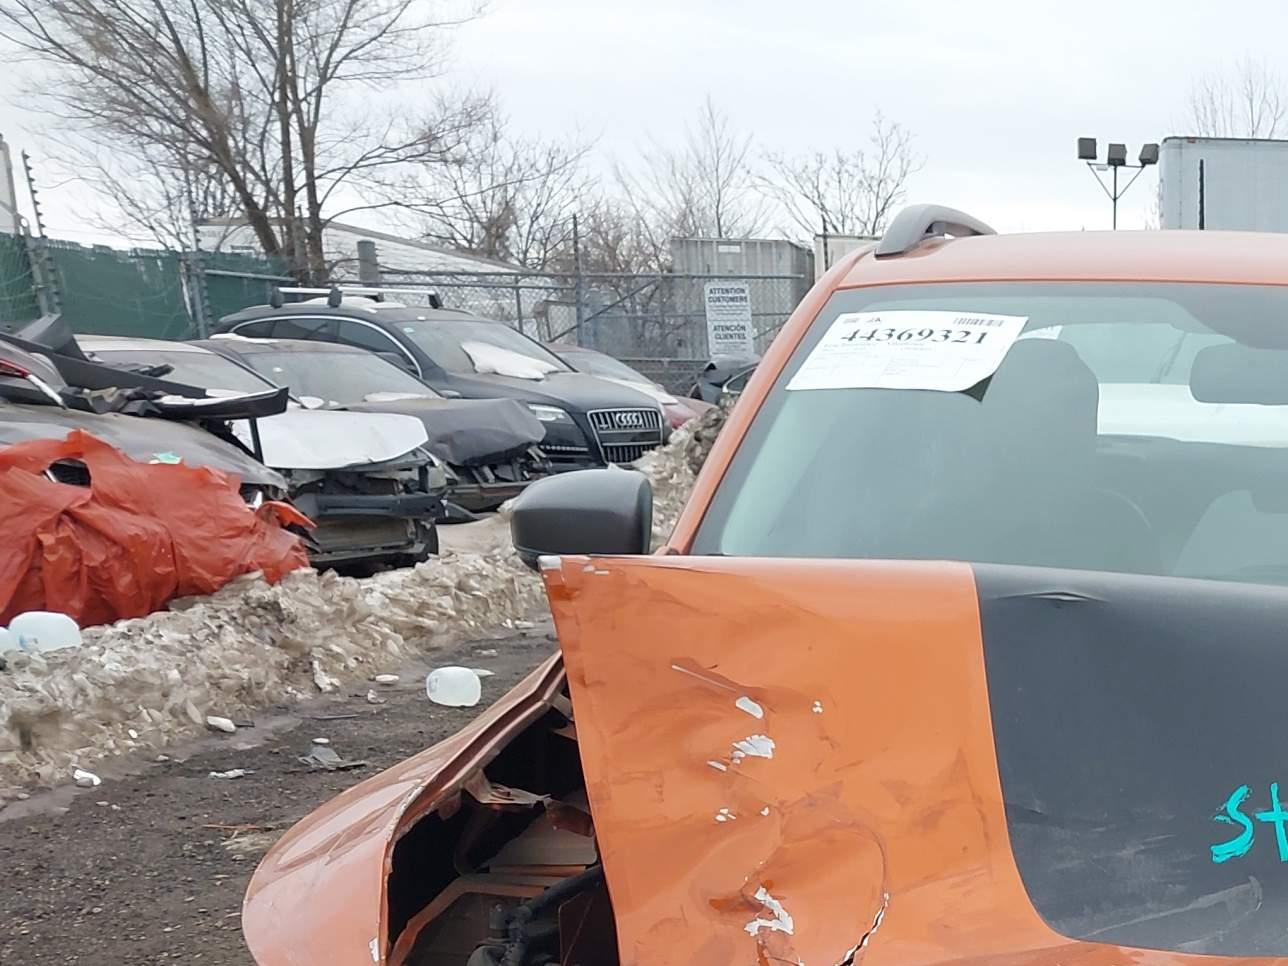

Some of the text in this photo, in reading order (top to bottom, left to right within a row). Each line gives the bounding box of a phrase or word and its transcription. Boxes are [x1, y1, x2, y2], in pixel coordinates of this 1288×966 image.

[709, 287, 746, 295] ATTENTION
[707, 296, 748, 304] CUSTOMERS
[840, 327, 989, 345] 44369321
